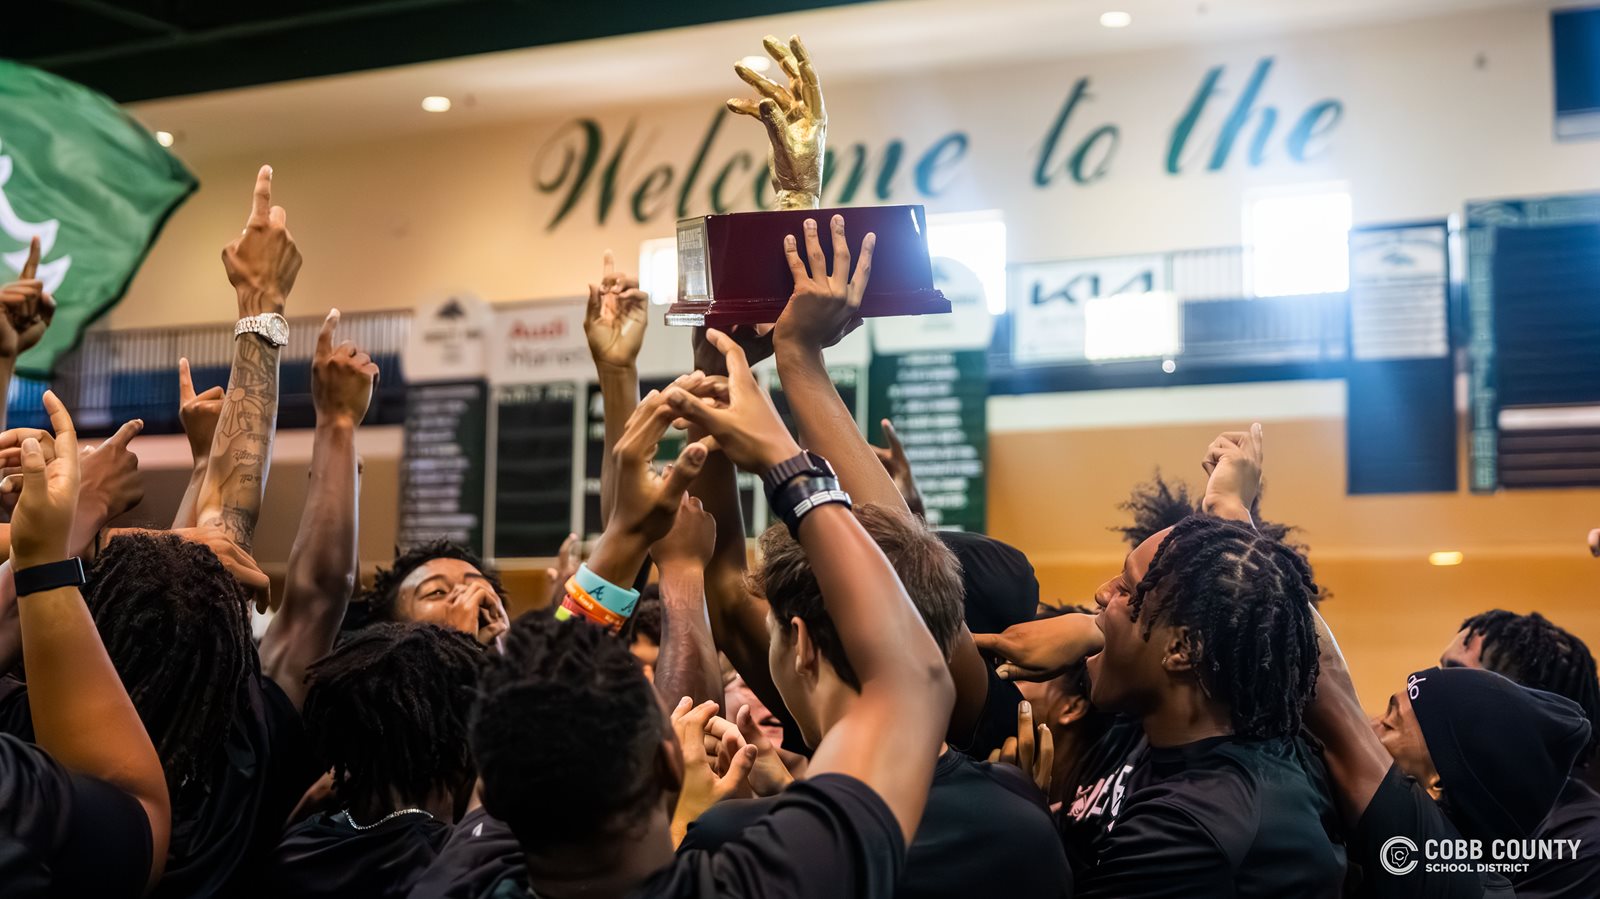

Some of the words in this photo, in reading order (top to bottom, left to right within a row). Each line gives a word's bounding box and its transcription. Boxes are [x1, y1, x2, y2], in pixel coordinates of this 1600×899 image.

[1032, 75, 1120, 188] to
[1163, 55, 1344, 176] the
[509, 318, 568, 340] Audi
